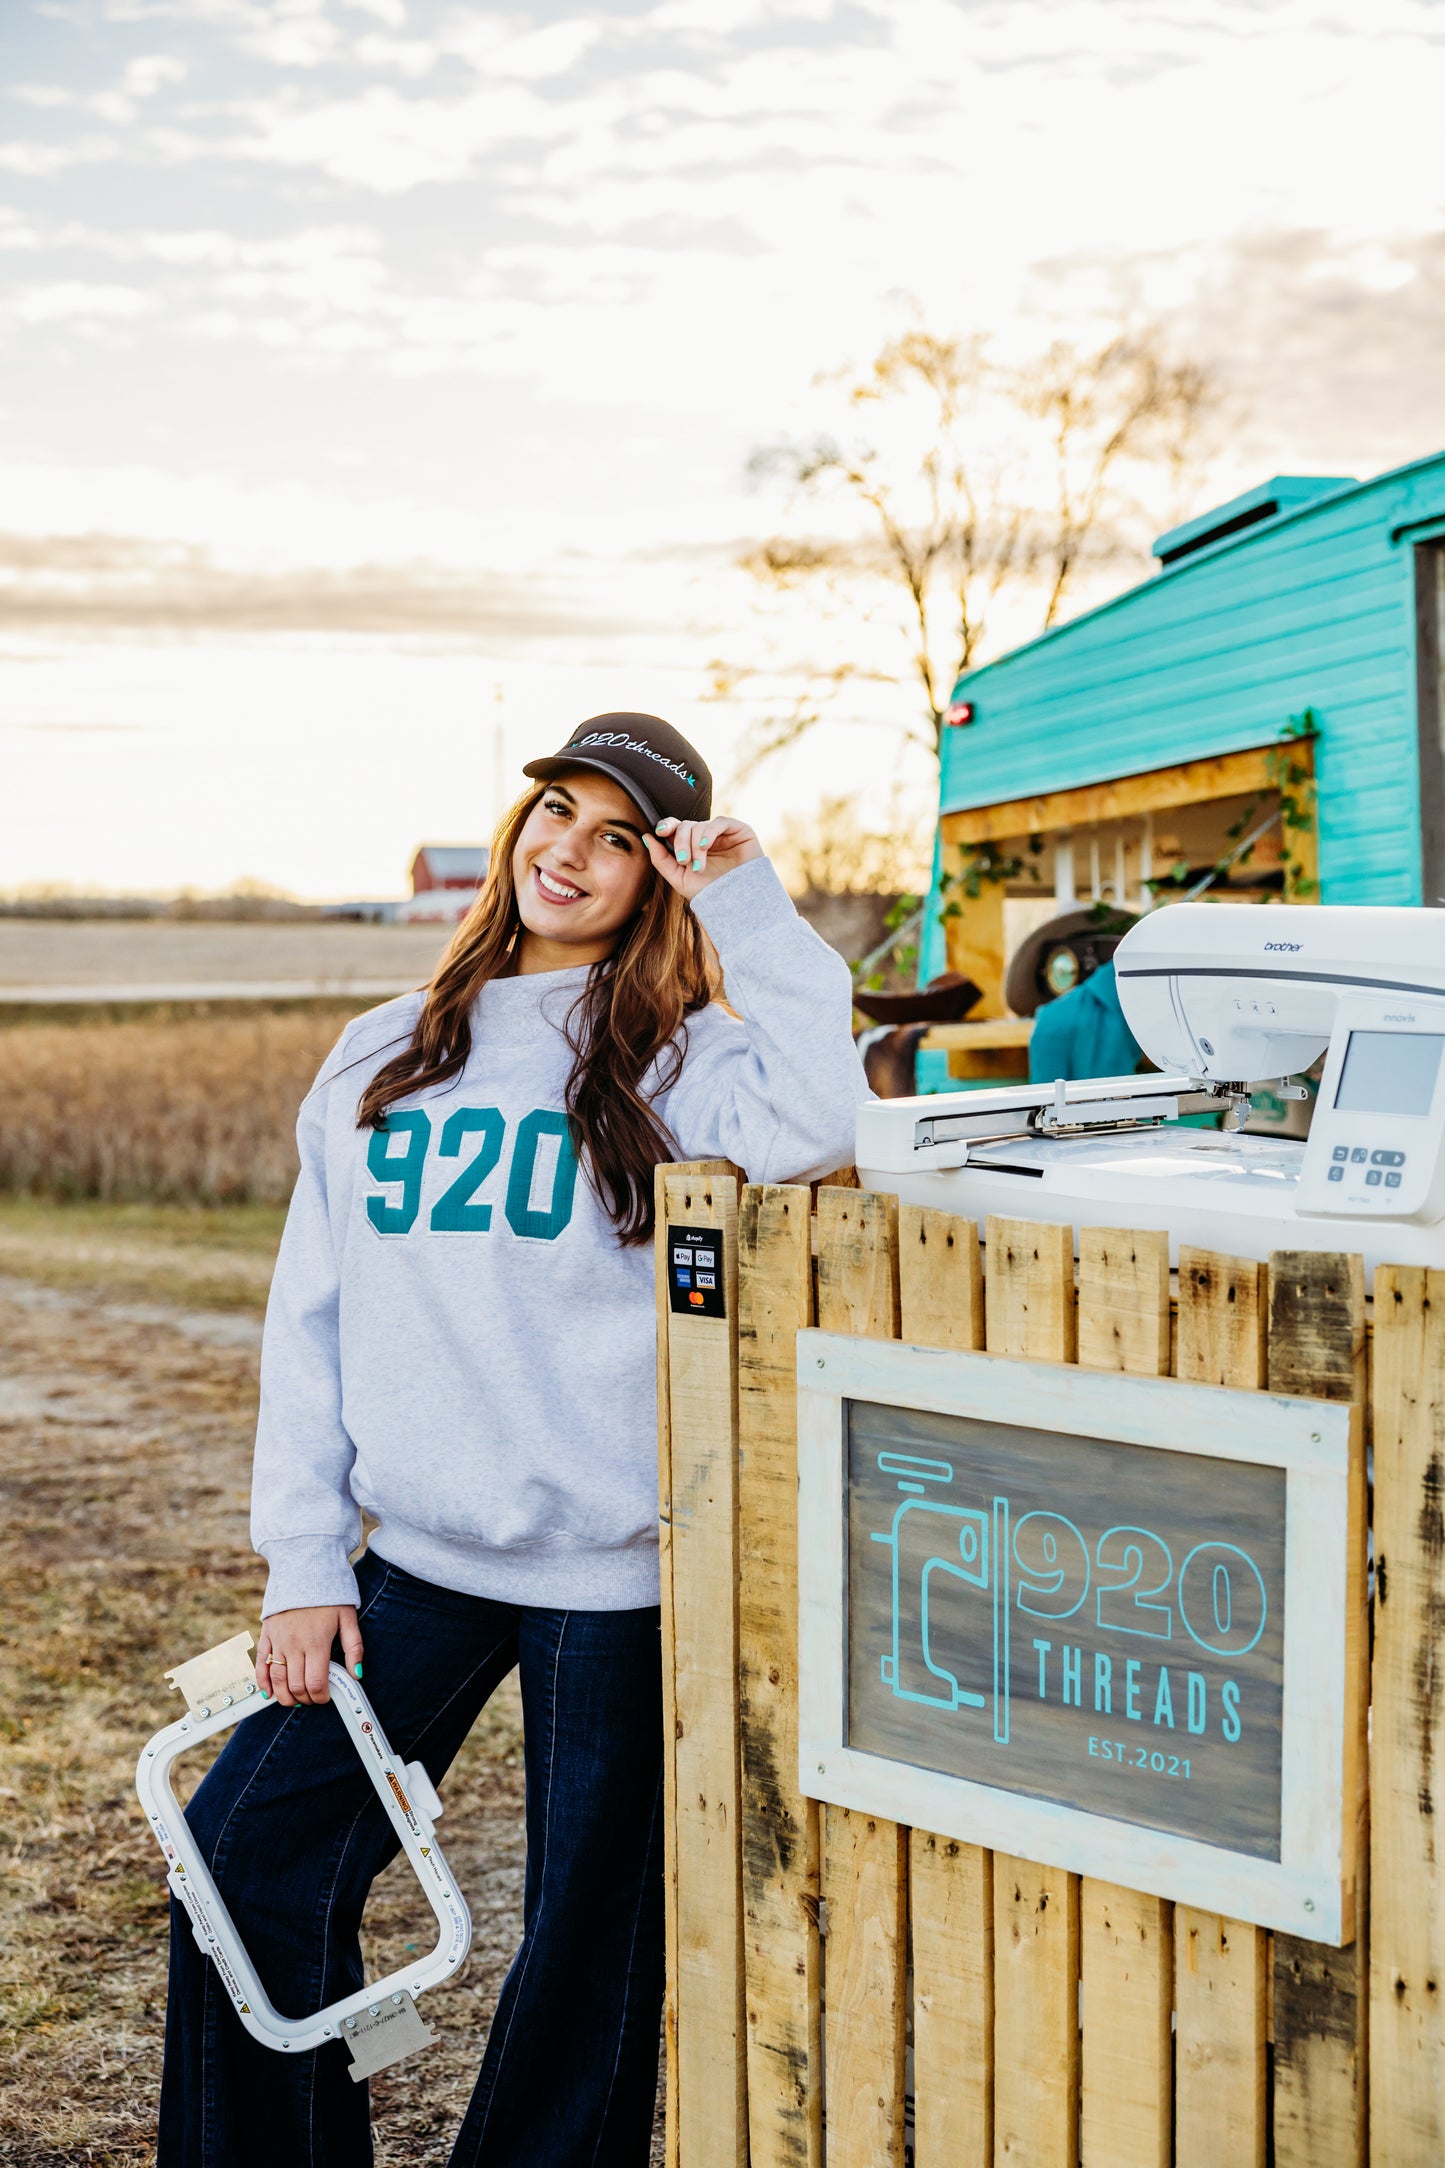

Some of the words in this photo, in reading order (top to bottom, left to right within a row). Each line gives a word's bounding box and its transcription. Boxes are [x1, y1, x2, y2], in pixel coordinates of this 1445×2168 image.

[580, 732, 688, 780] 920threads
[1264, 942, 1304, 952] brother
[363, 1104, 580, 1241] 920
[681, 1253, 690, 1262] Pay
[699, 1276, 713, 1285] VISA
[1012, 1510, 1268, 1657] 920
[1032, 1638, 1242, 1744] THREADS
[1087, 1735, 1192, 1780] EST.2021
[390, 1780, 409, 1811] WARNING
